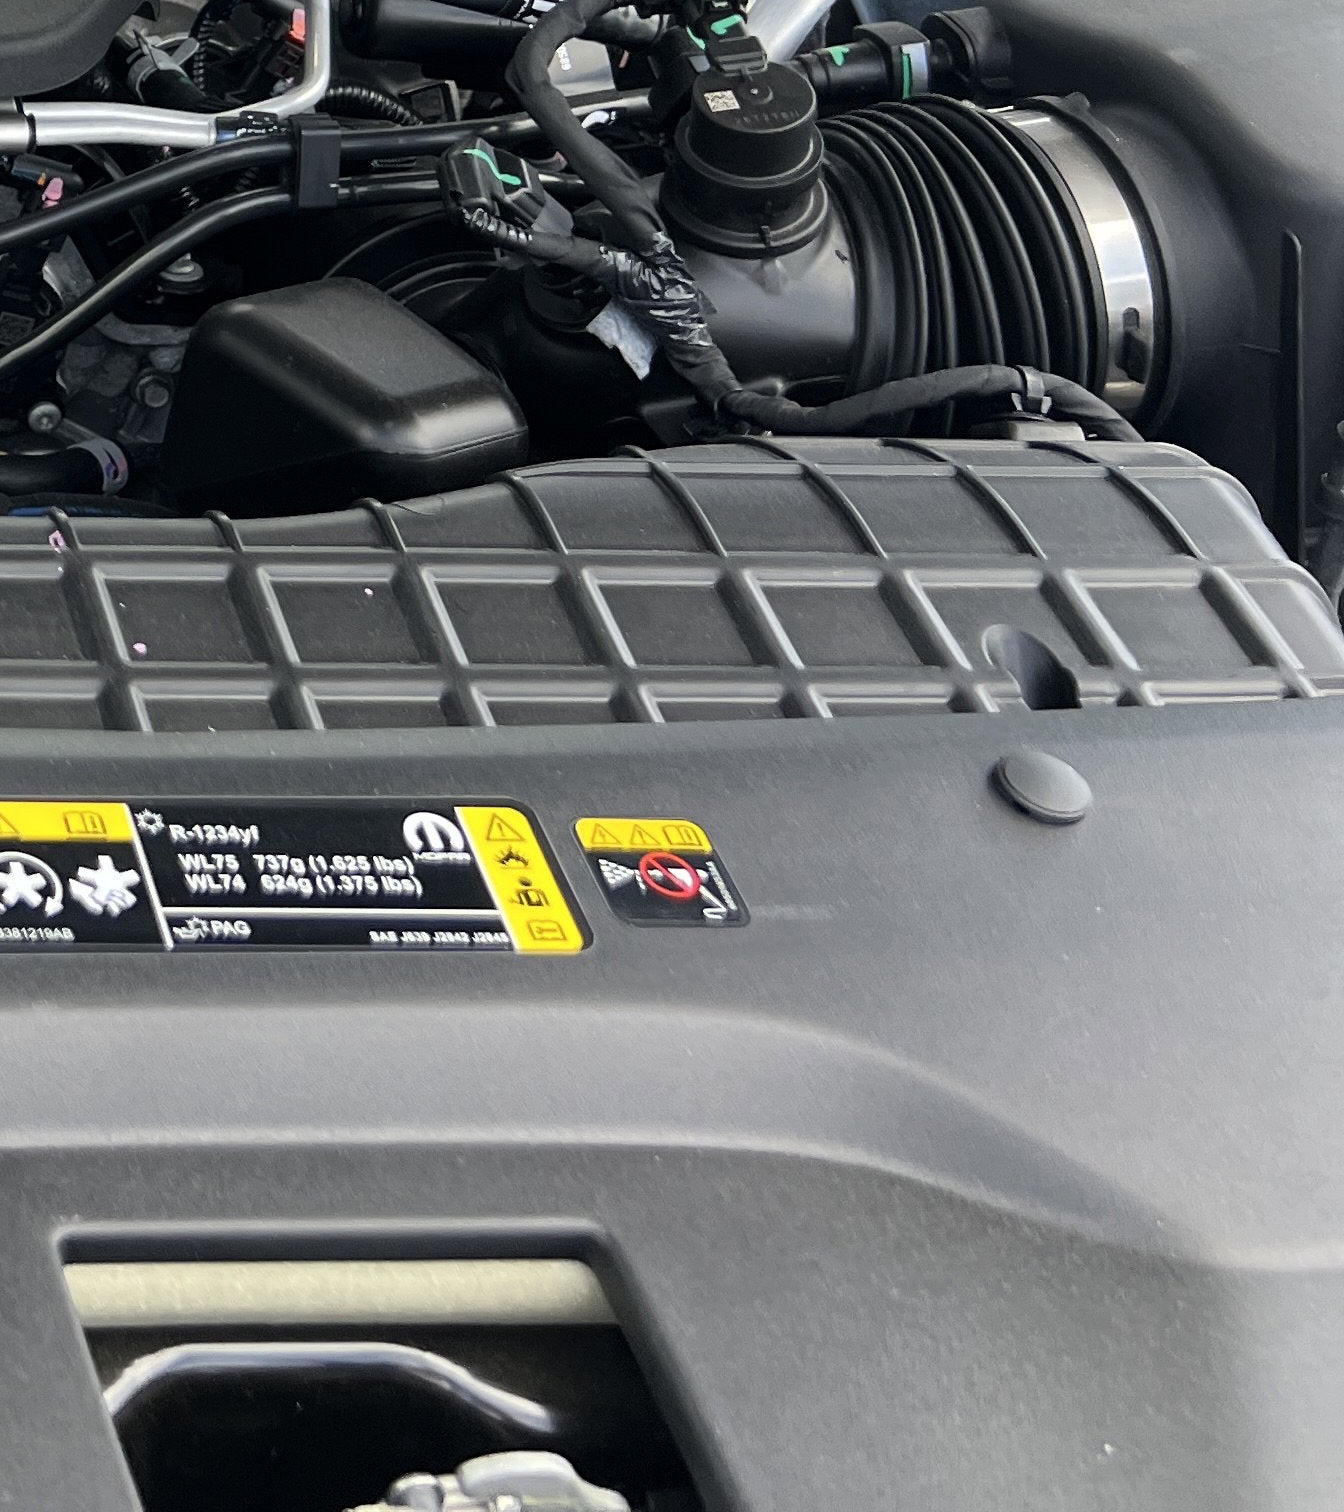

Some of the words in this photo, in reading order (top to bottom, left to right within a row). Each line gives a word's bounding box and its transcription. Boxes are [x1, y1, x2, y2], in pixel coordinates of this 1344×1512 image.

[168, 824, 260, 849] R-1234yf
[177, 853, 240, 874] WL75
[253, 854, 306, 876] 737g
[308, 854, 372, 876] (1.625
[372, 854, 414, 876] lbs)
[184, 873, 247, 896] WL74
[261, 874, 313, 899] 624g
[315, 874, 379, 896] (1.375
[381, 874, 424, 900] lbs)
[210, 919, 252, 939] PAG
